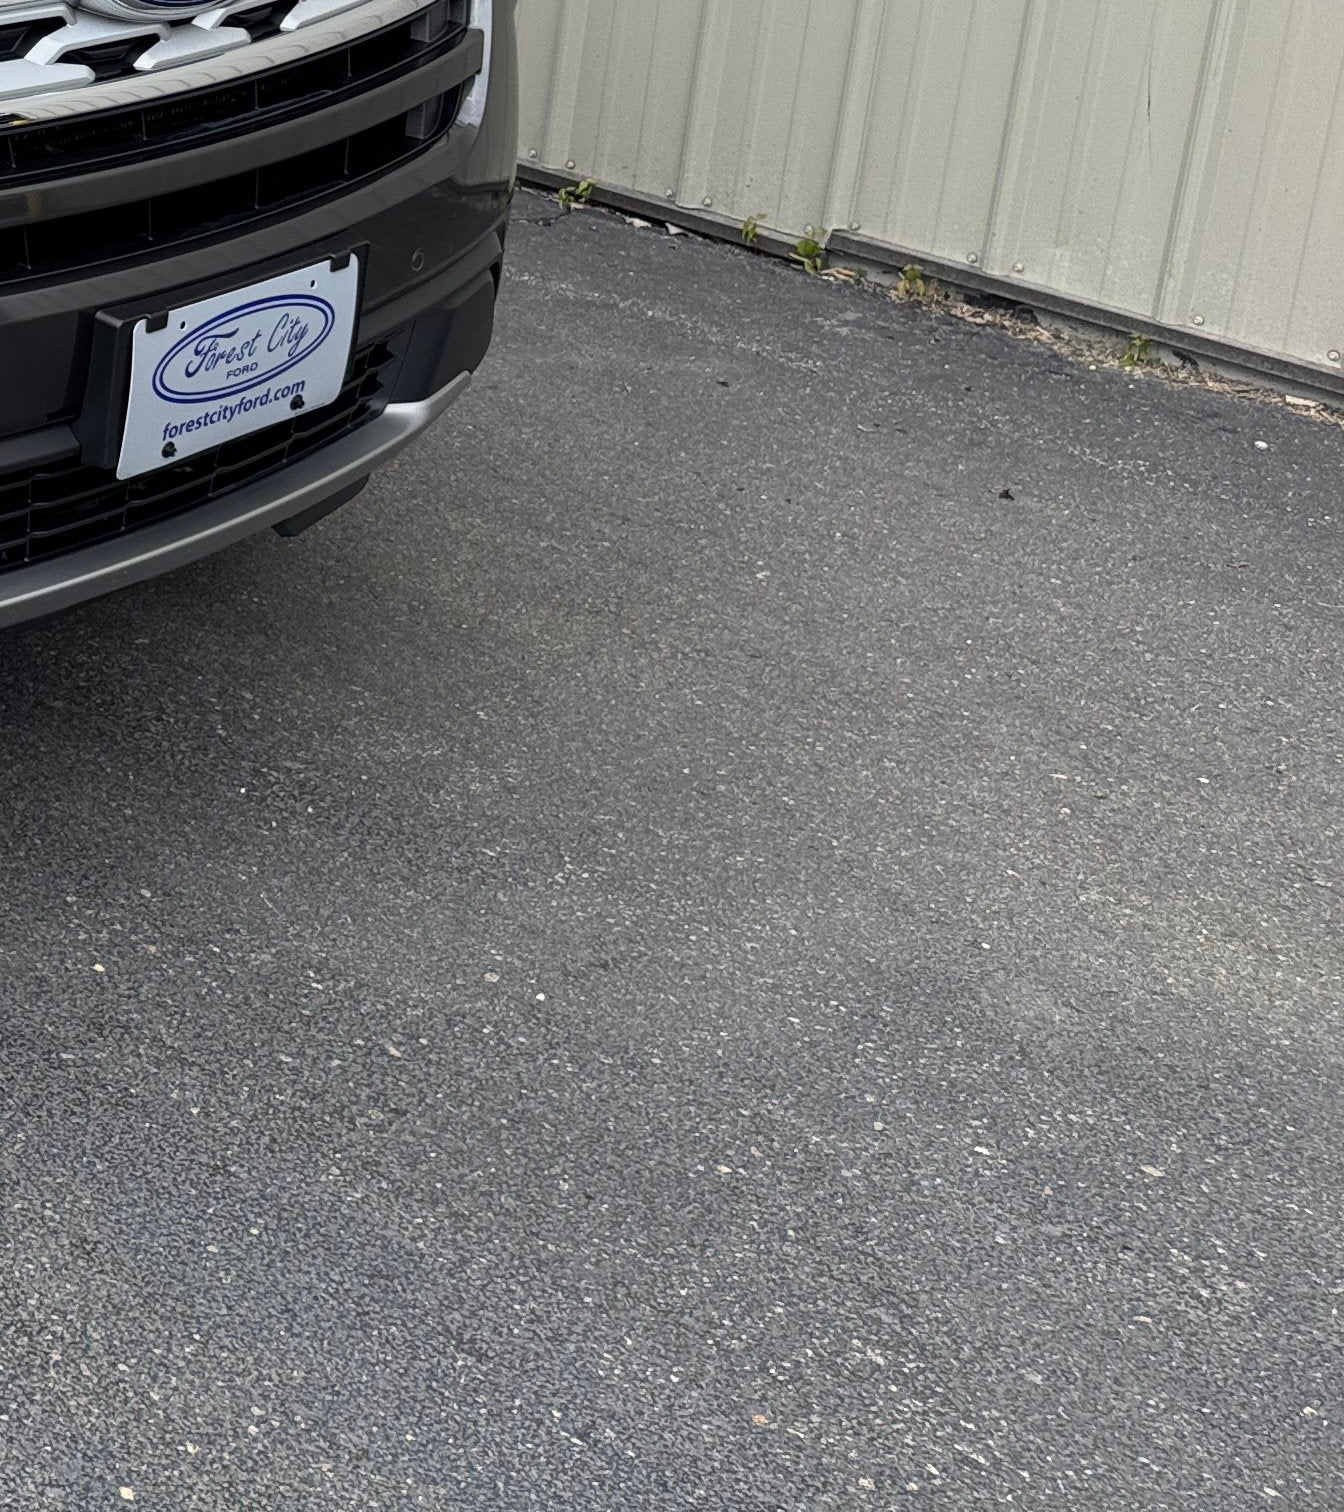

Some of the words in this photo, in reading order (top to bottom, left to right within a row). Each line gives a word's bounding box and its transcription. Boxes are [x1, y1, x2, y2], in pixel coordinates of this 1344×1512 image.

[184, 327, 262, 378] Forest
[266, 312, 309, 357] City
[225, 361, 259, 380] FORD
[162, 380, 306, 441] forestcityford.com
